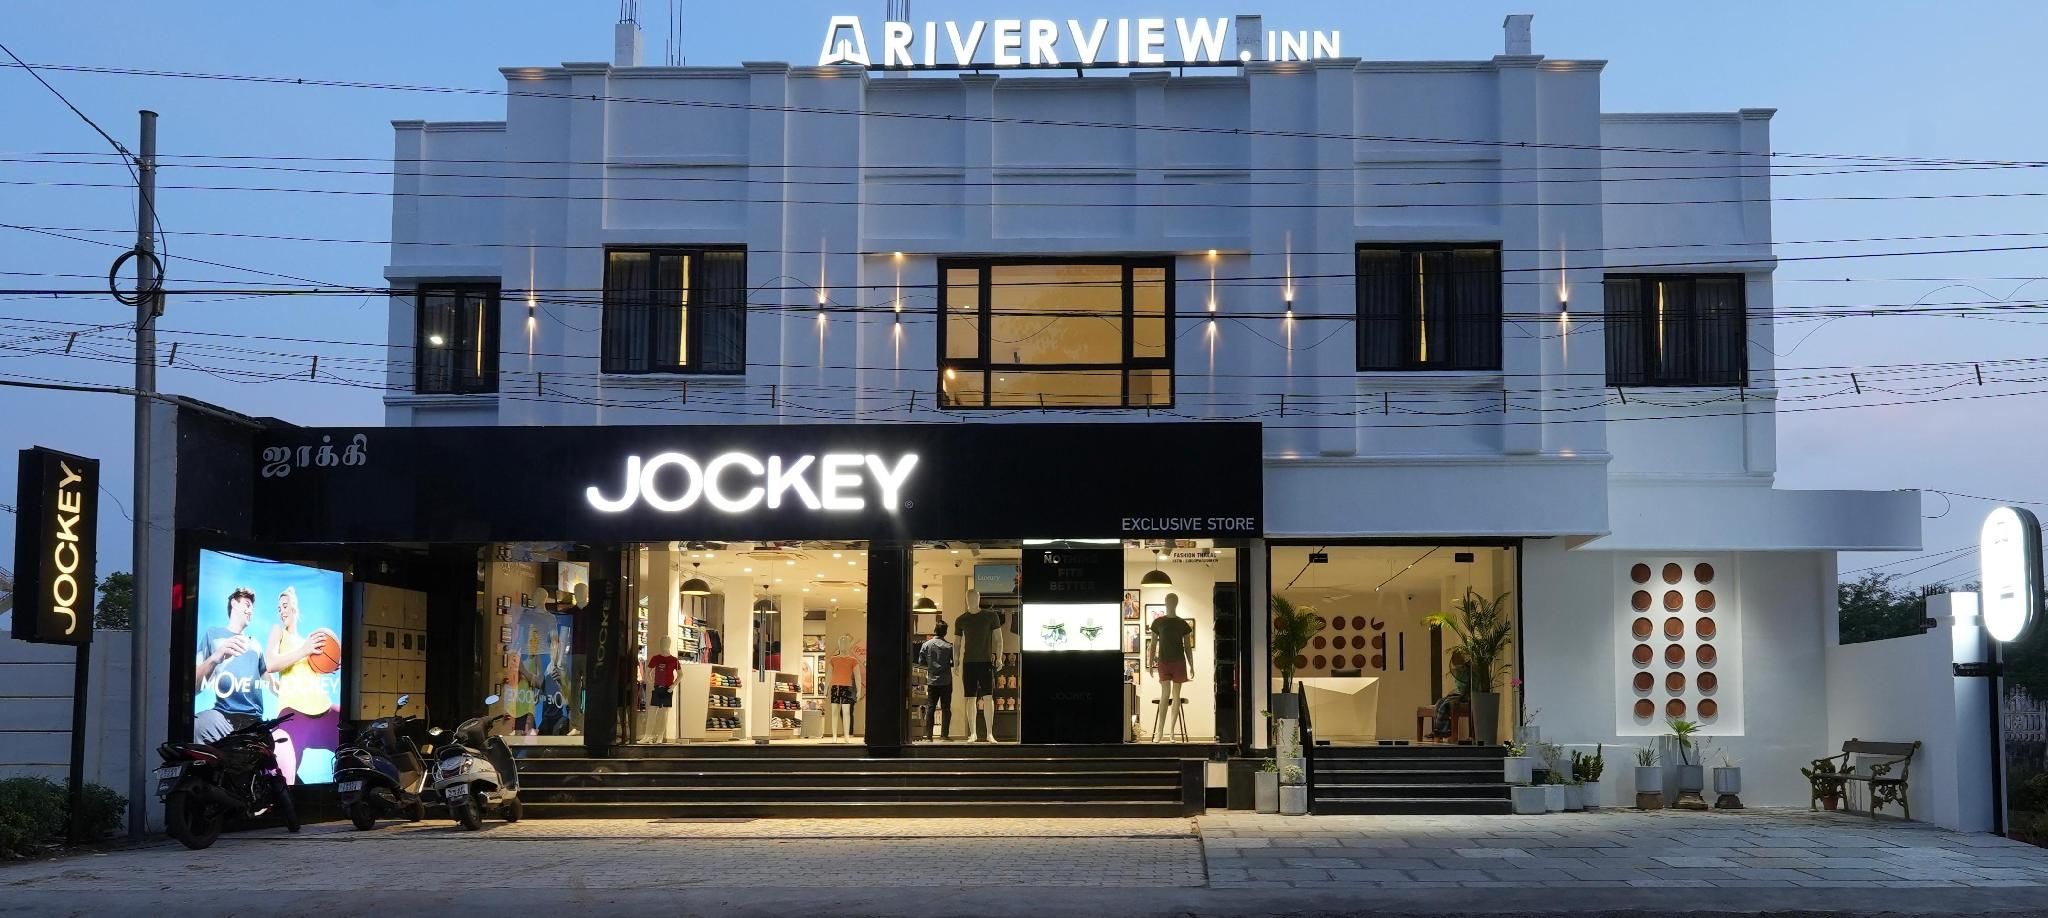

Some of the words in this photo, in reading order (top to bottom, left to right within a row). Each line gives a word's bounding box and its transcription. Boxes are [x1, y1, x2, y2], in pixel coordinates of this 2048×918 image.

[1268, 30, 1340, 60] INN
[262, 433, 368, 478] ஜாக்கி
[586, 452, 918, 512] JOCKEY
[1121, 517, 1203, 531] EXCLUSIVE
[1207, 517, 1255, 531] STORE
[53, 460, 83, 636] JOCKEY
[200, 671, 252, 699] MOVE
